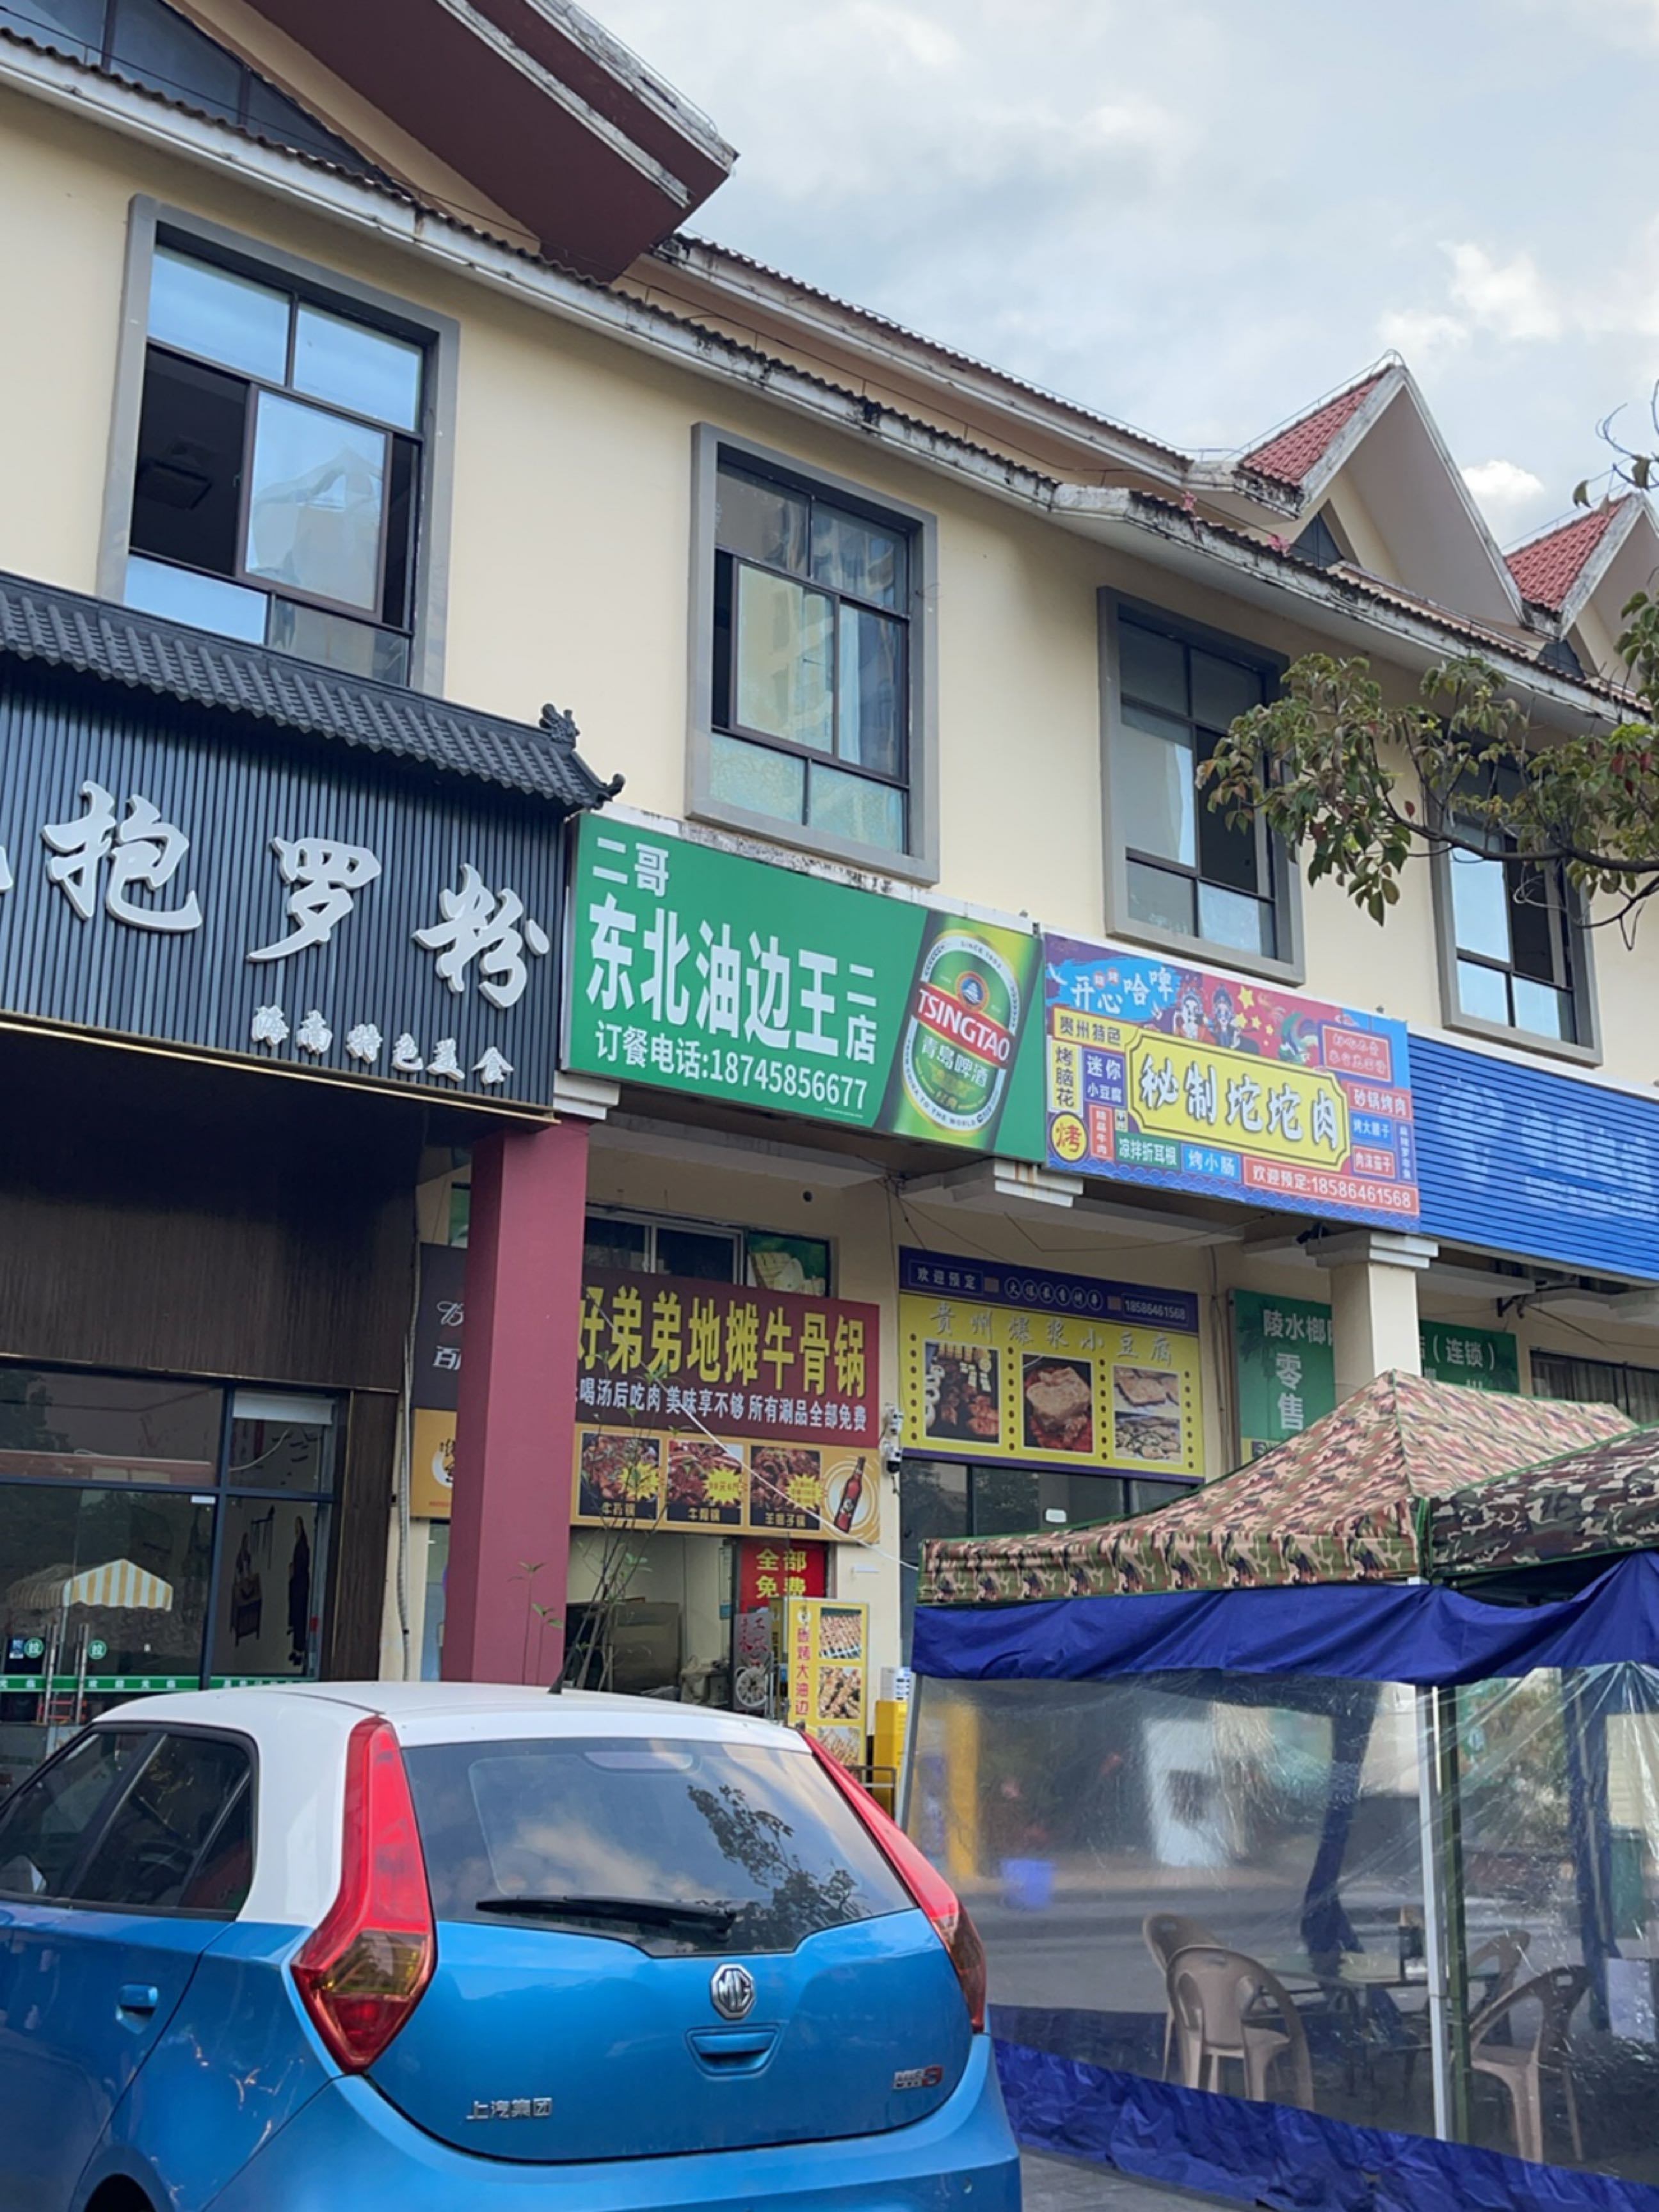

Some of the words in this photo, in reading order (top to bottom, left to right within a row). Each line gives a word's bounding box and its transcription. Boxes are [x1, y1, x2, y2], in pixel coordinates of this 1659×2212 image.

[593, 837, 669, 898] 二哥
[0, 780, 551, 1009] 抱罗粉
[586, 893, 839, 1058] 东北油边王
[918, 989, 1010, 1061] TSINGTAO
[1060, 1016, 1121, 1045] 贵州特色
[251, 1005, 514, 1087] 海南特色美食
[922, 1035, 988, 1087] 青岛啤酒
[1055, 1046, 1074, 1107] 烤脑花
[1087, 1054, 1122, 1080] 迷你
[1087, 1082, 1122, 1103] 小豆腐
[1140, 1054, 1338, 1150] 秘制坨坨肉
[1354, 1088, 1407, 1116] 砂锅烤肉
[1055, 1121, 1082, 1153] 烤
[917, 1266, 977, 1291] 欢迎预定
[576, 1377, 661, 1412] 喝汤后吃肉
[1276, 1353, 1304, 1431] 零售
[756, 1548, 807, 1573] 全部
[756, 1575, 806, 1599] 免费
[715, 1967, 754, 2014] MG
[466, 2096, 553, 2120] 上汽集团
